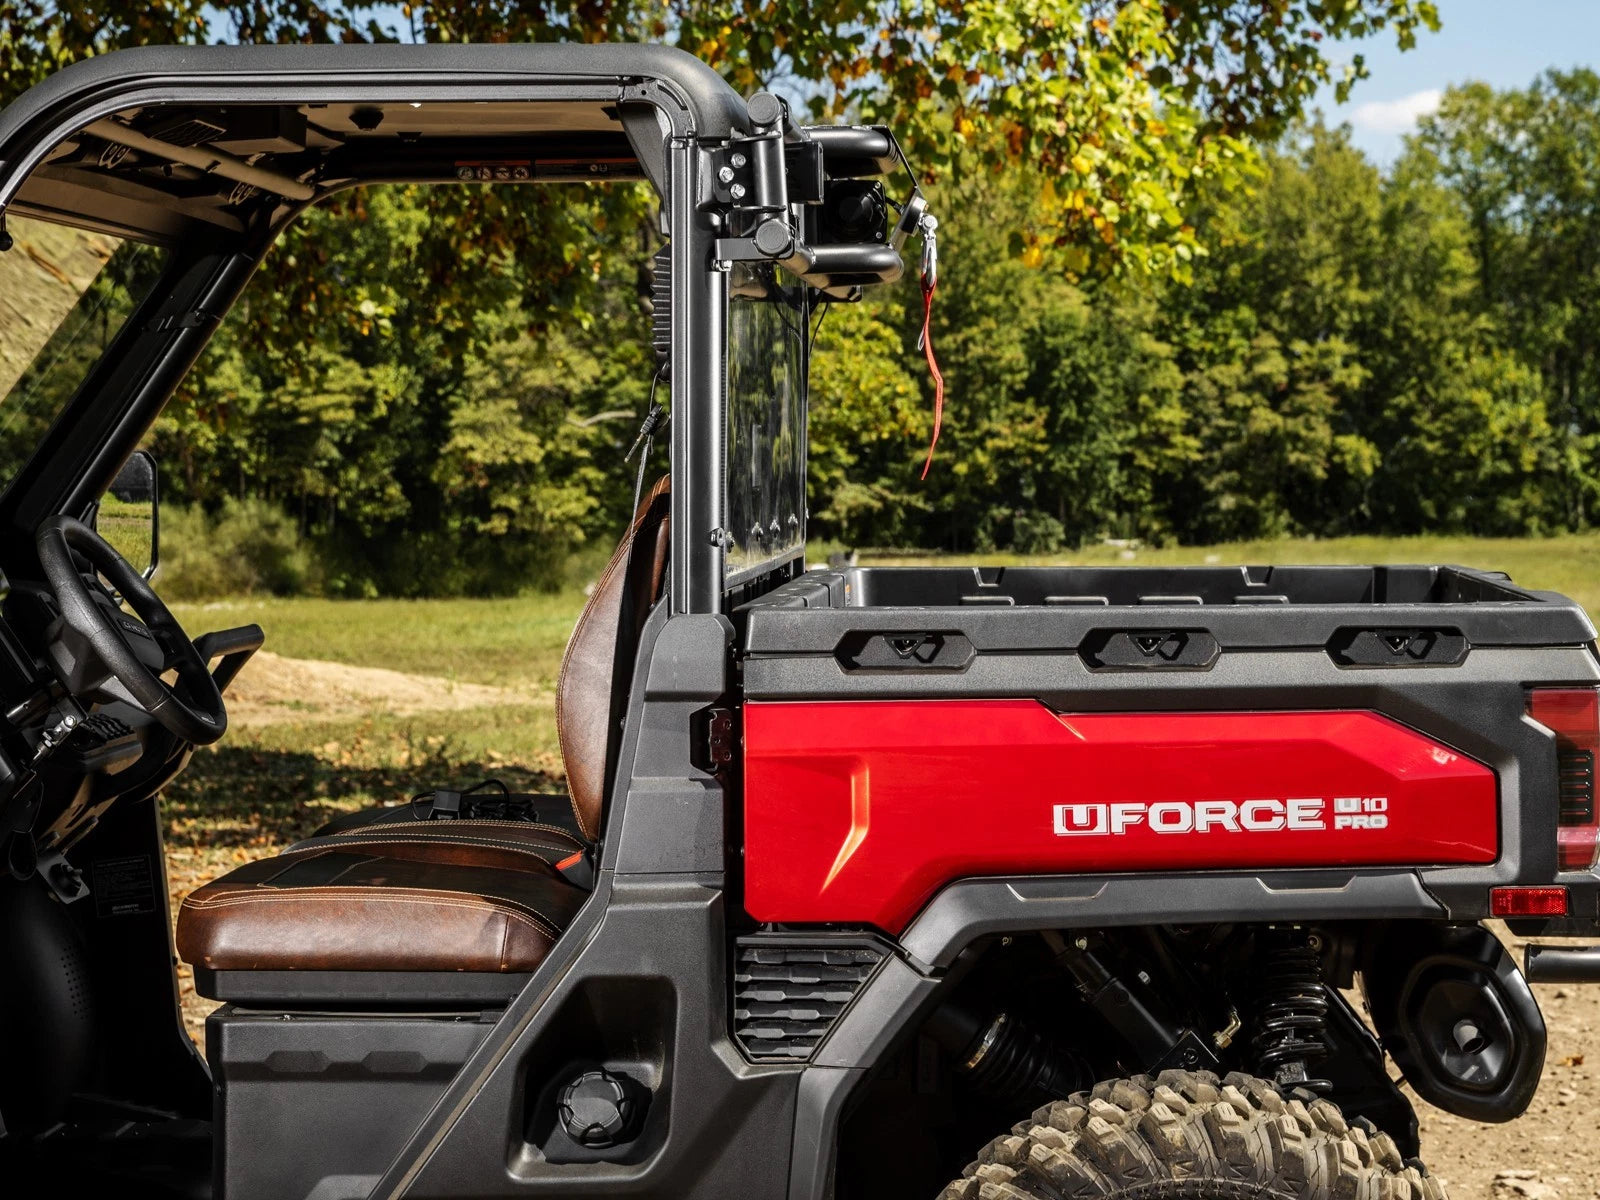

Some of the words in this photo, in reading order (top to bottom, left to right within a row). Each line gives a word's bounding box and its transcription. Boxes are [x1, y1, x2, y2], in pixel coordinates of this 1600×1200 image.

[1053, 798, 1326, 836] UFORCE
[1334, 797, 1388, 813] U10
[1334, 814, 1388, 829] PRO
